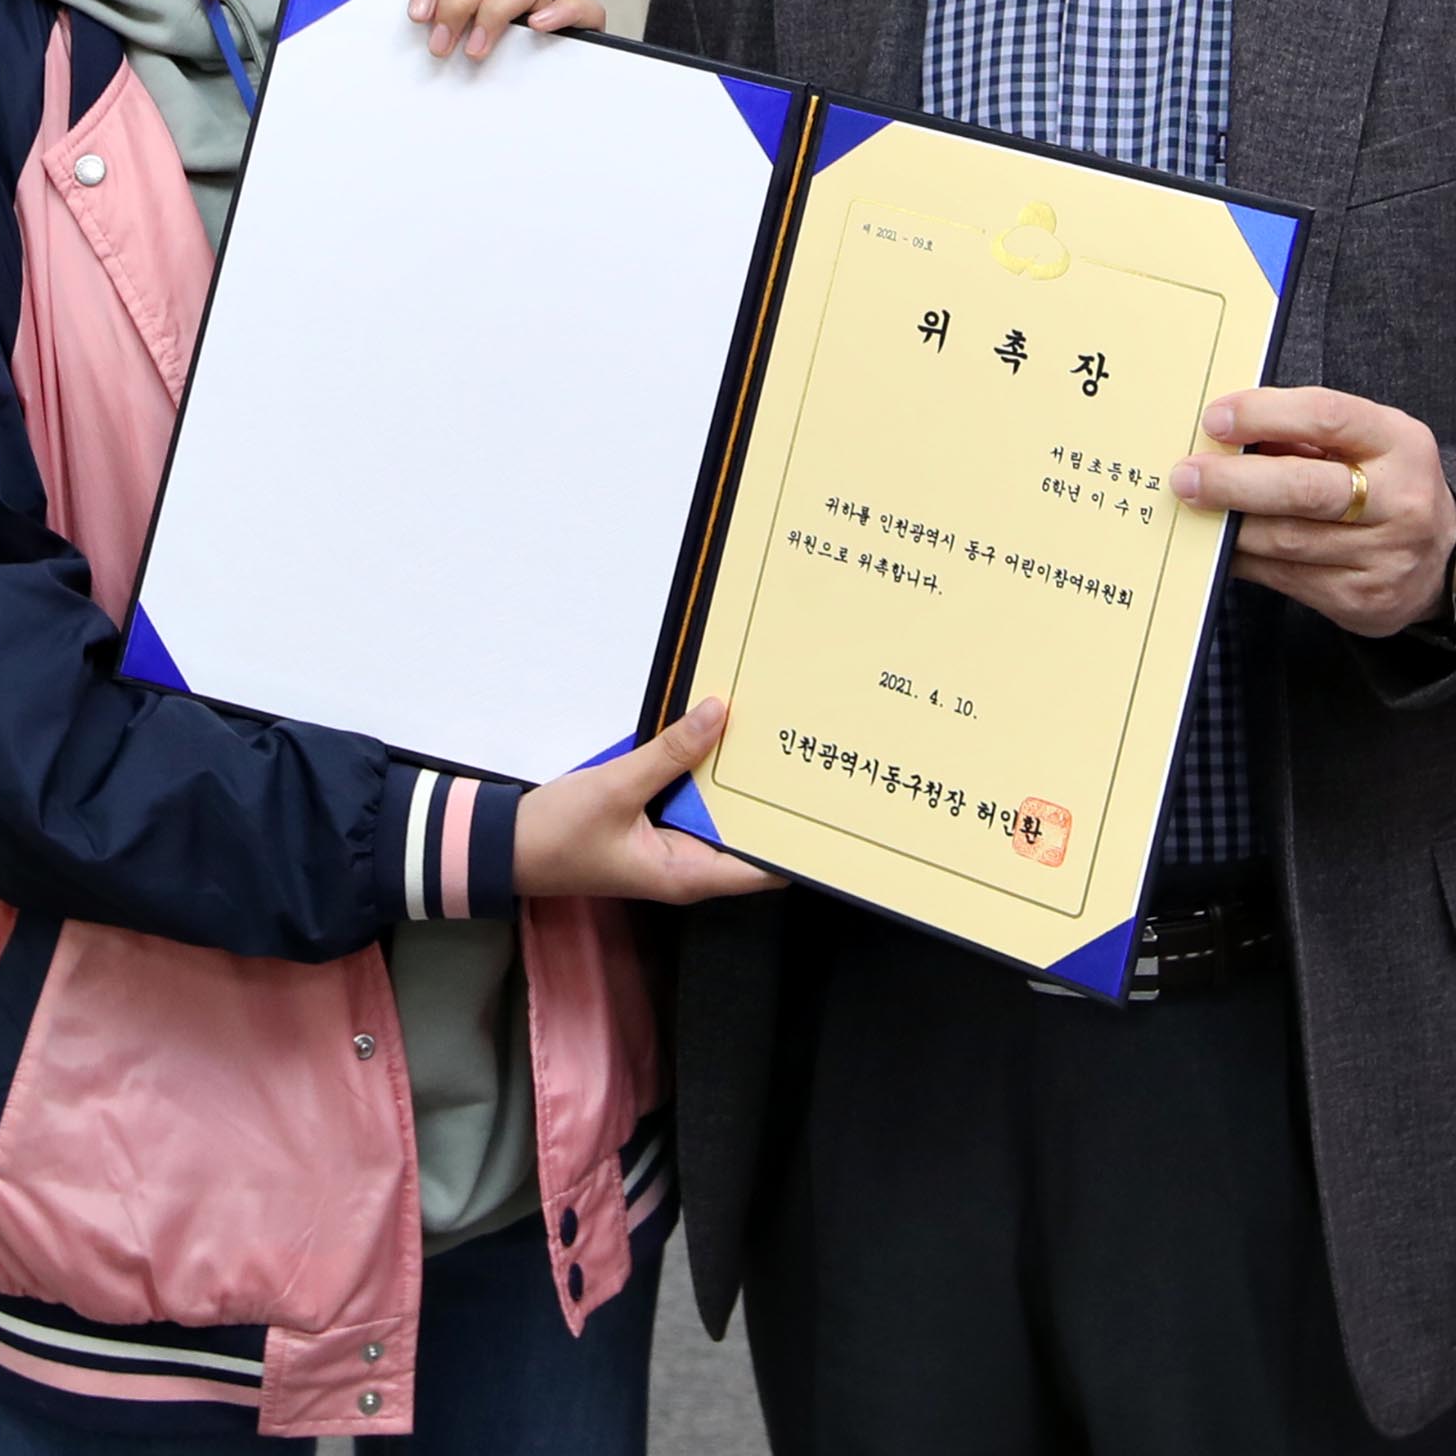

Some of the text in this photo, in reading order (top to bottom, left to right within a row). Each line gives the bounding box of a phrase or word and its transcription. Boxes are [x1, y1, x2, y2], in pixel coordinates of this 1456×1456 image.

[876, 226, 897, 242] 2021
[1041, 476, 1081, 504] 6학년
[1050, 446, 1161, 491] 서림초등학교
[787, 530, 943, 596] 위원으로 위촉합니다.
[825, 497, 1134, 610] 귀하를 인천광역시 동구 어린이참여위원회
[878, 671, 977, 720] 2021. 4. 10.
[779, 729, 967, 817] 인천광역시동구청장
[977, 801, 1042, 845] 허인환
